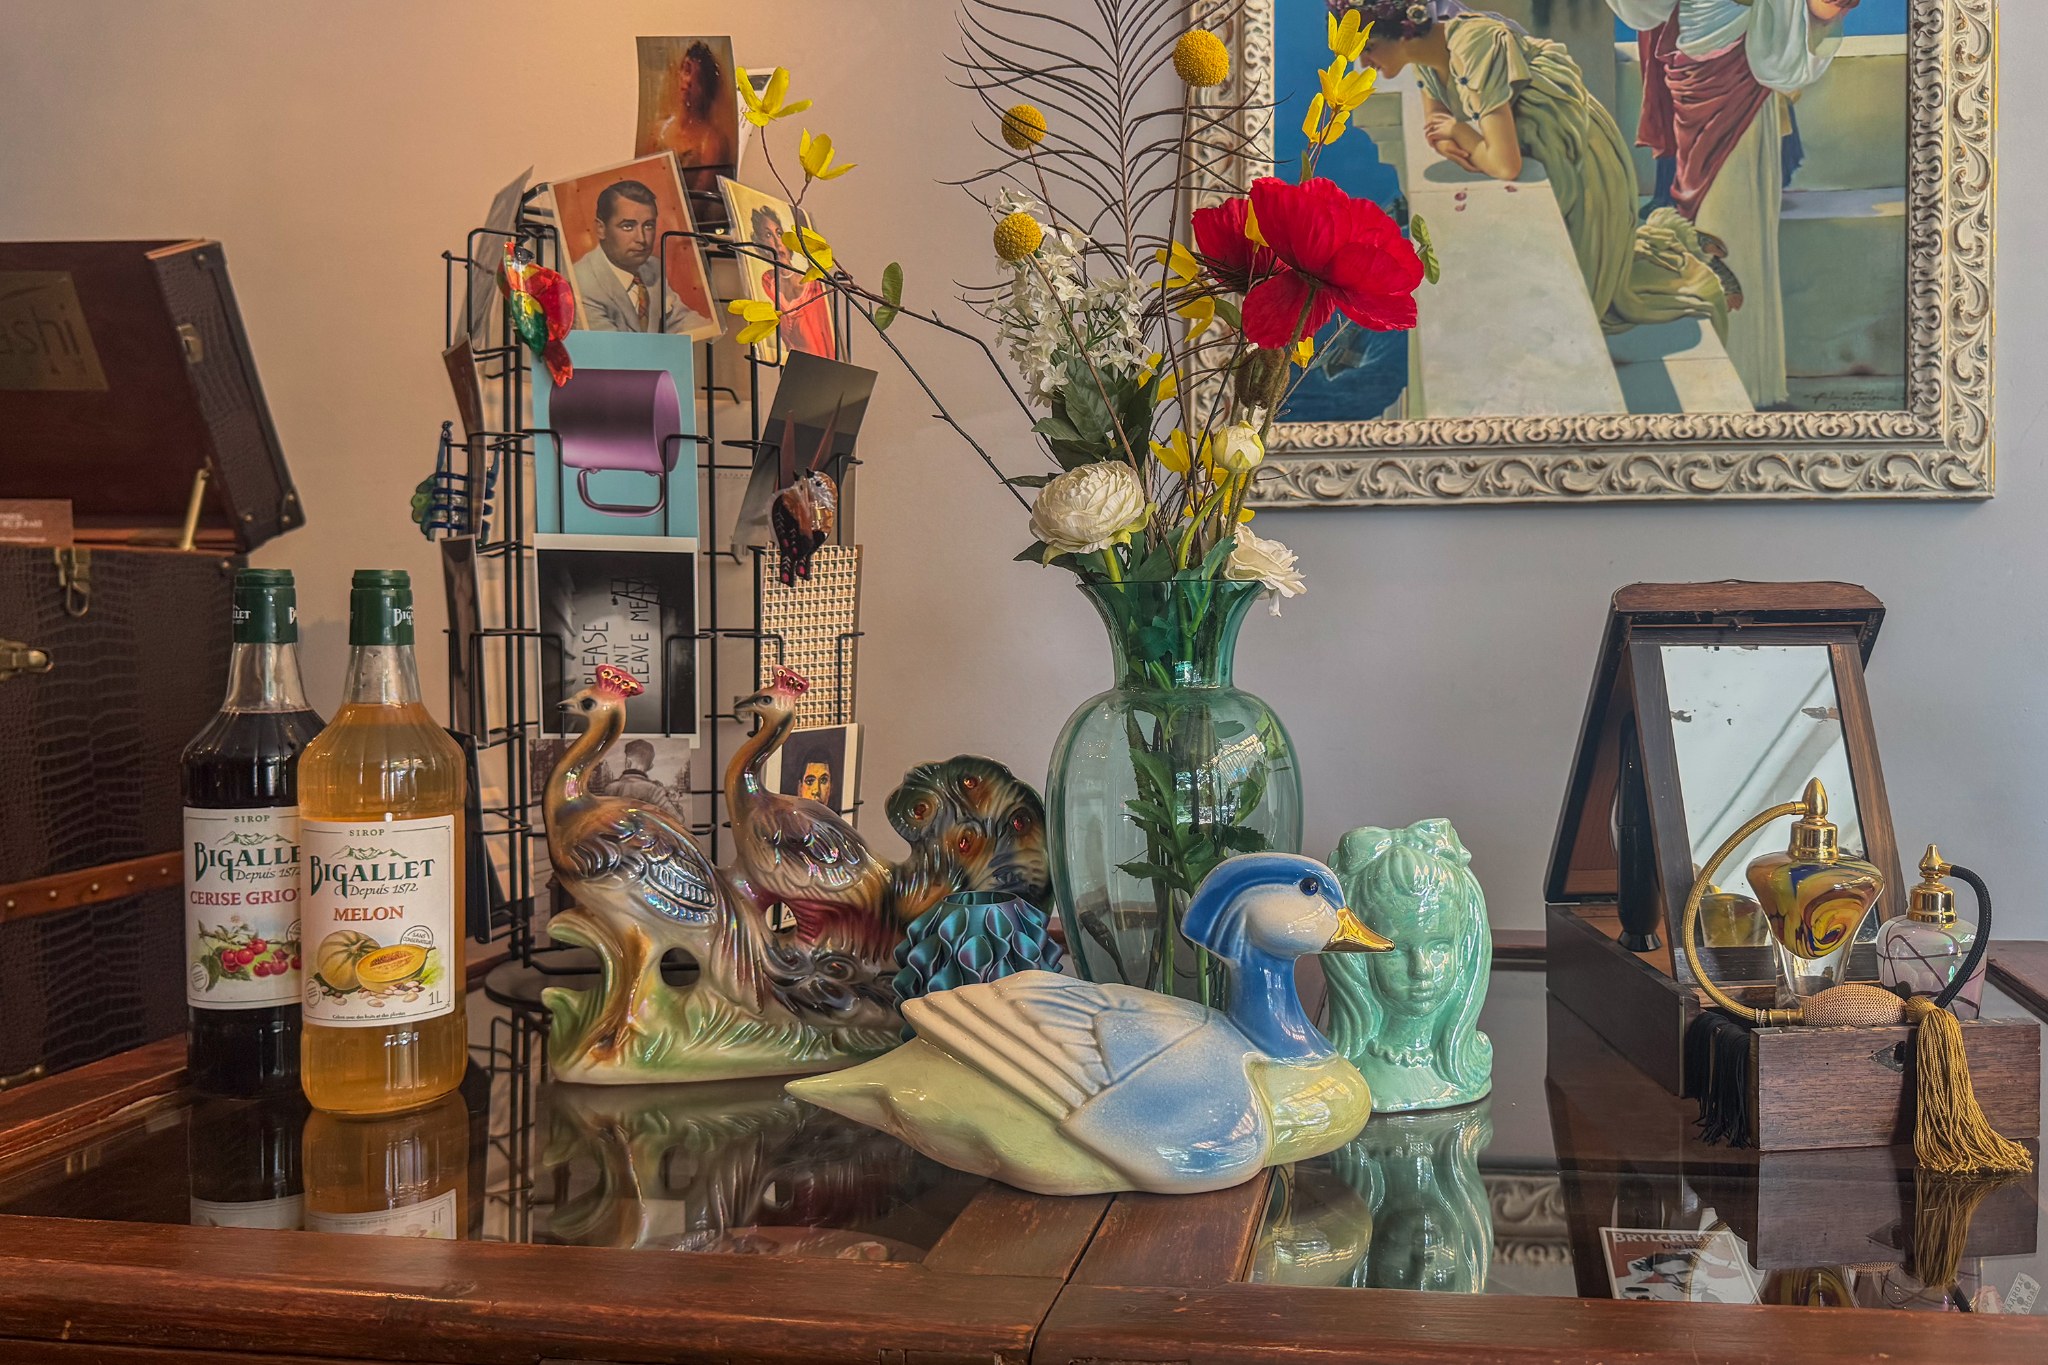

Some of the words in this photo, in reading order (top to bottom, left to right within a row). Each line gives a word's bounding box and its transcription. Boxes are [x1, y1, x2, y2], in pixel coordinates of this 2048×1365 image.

[614, 644, 630, 673] ONT
[234, 814, 270, 823] SIROP
[349, 828, 385, 837] SIROP
[221, 867, 276, 884] Depuis
[310, 855, 436, 899] BIGALLET
[190, 890, 241, 906] CERISE
[245, 888, 301, 905] GRIO
[336, 883, 389, 899] Depuis
[392, 882, 419, 895] 1872
[333, 905, 404, 921] MELON
[428, 990, 443, 1006] 1L
[1614, 1231, 1722, 1243] BRYLCREE
